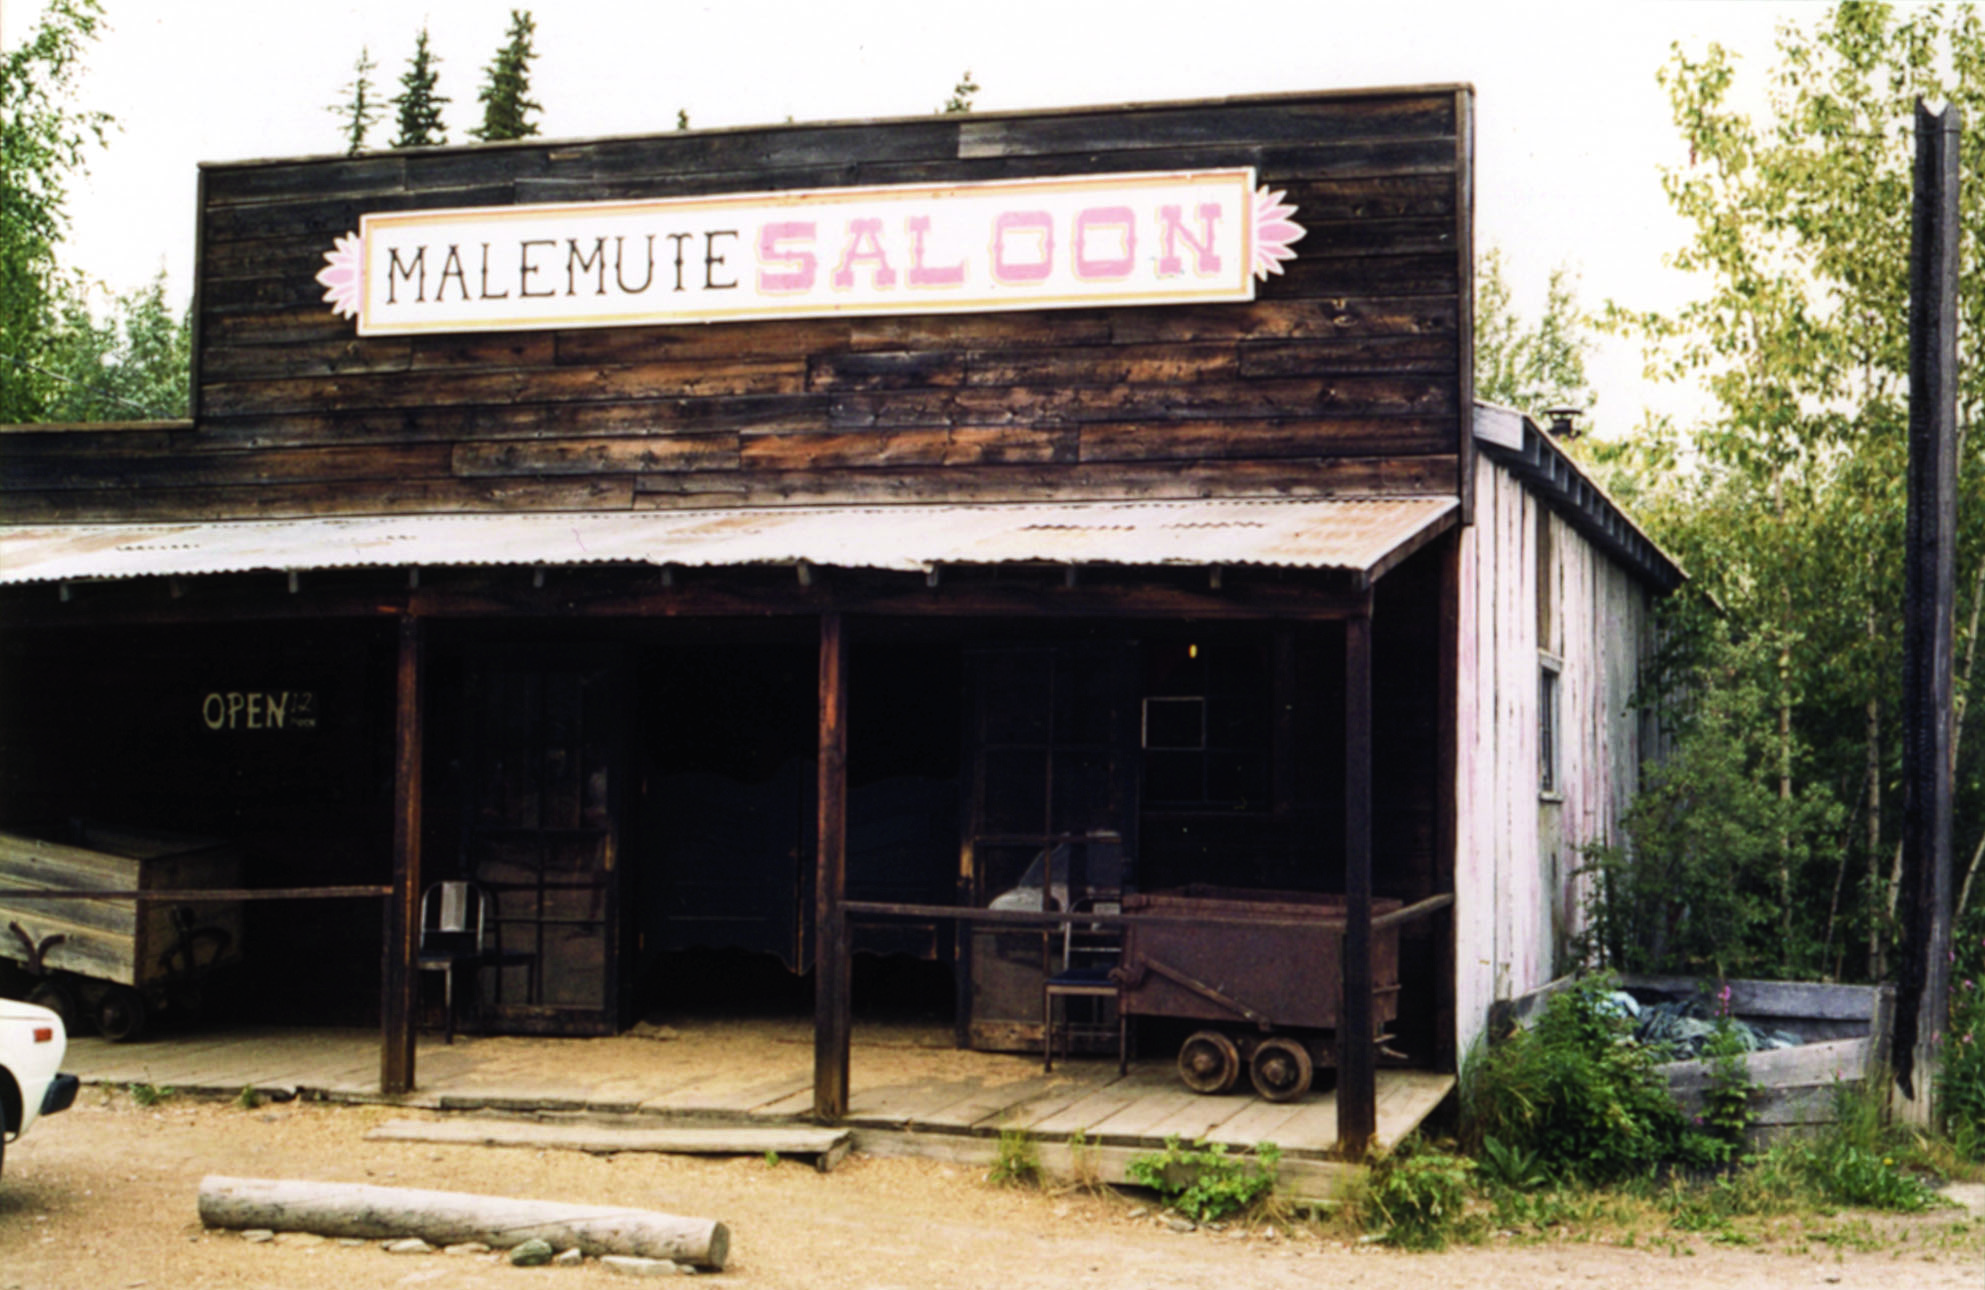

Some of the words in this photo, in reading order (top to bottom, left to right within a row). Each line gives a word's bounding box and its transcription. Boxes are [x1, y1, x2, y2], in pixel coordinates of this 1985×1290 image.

[386, 230, 739, 304] MALEMUTE
[755, 203, 1222, 293] SALOON
[203, 691, 289, 730] OPEN
